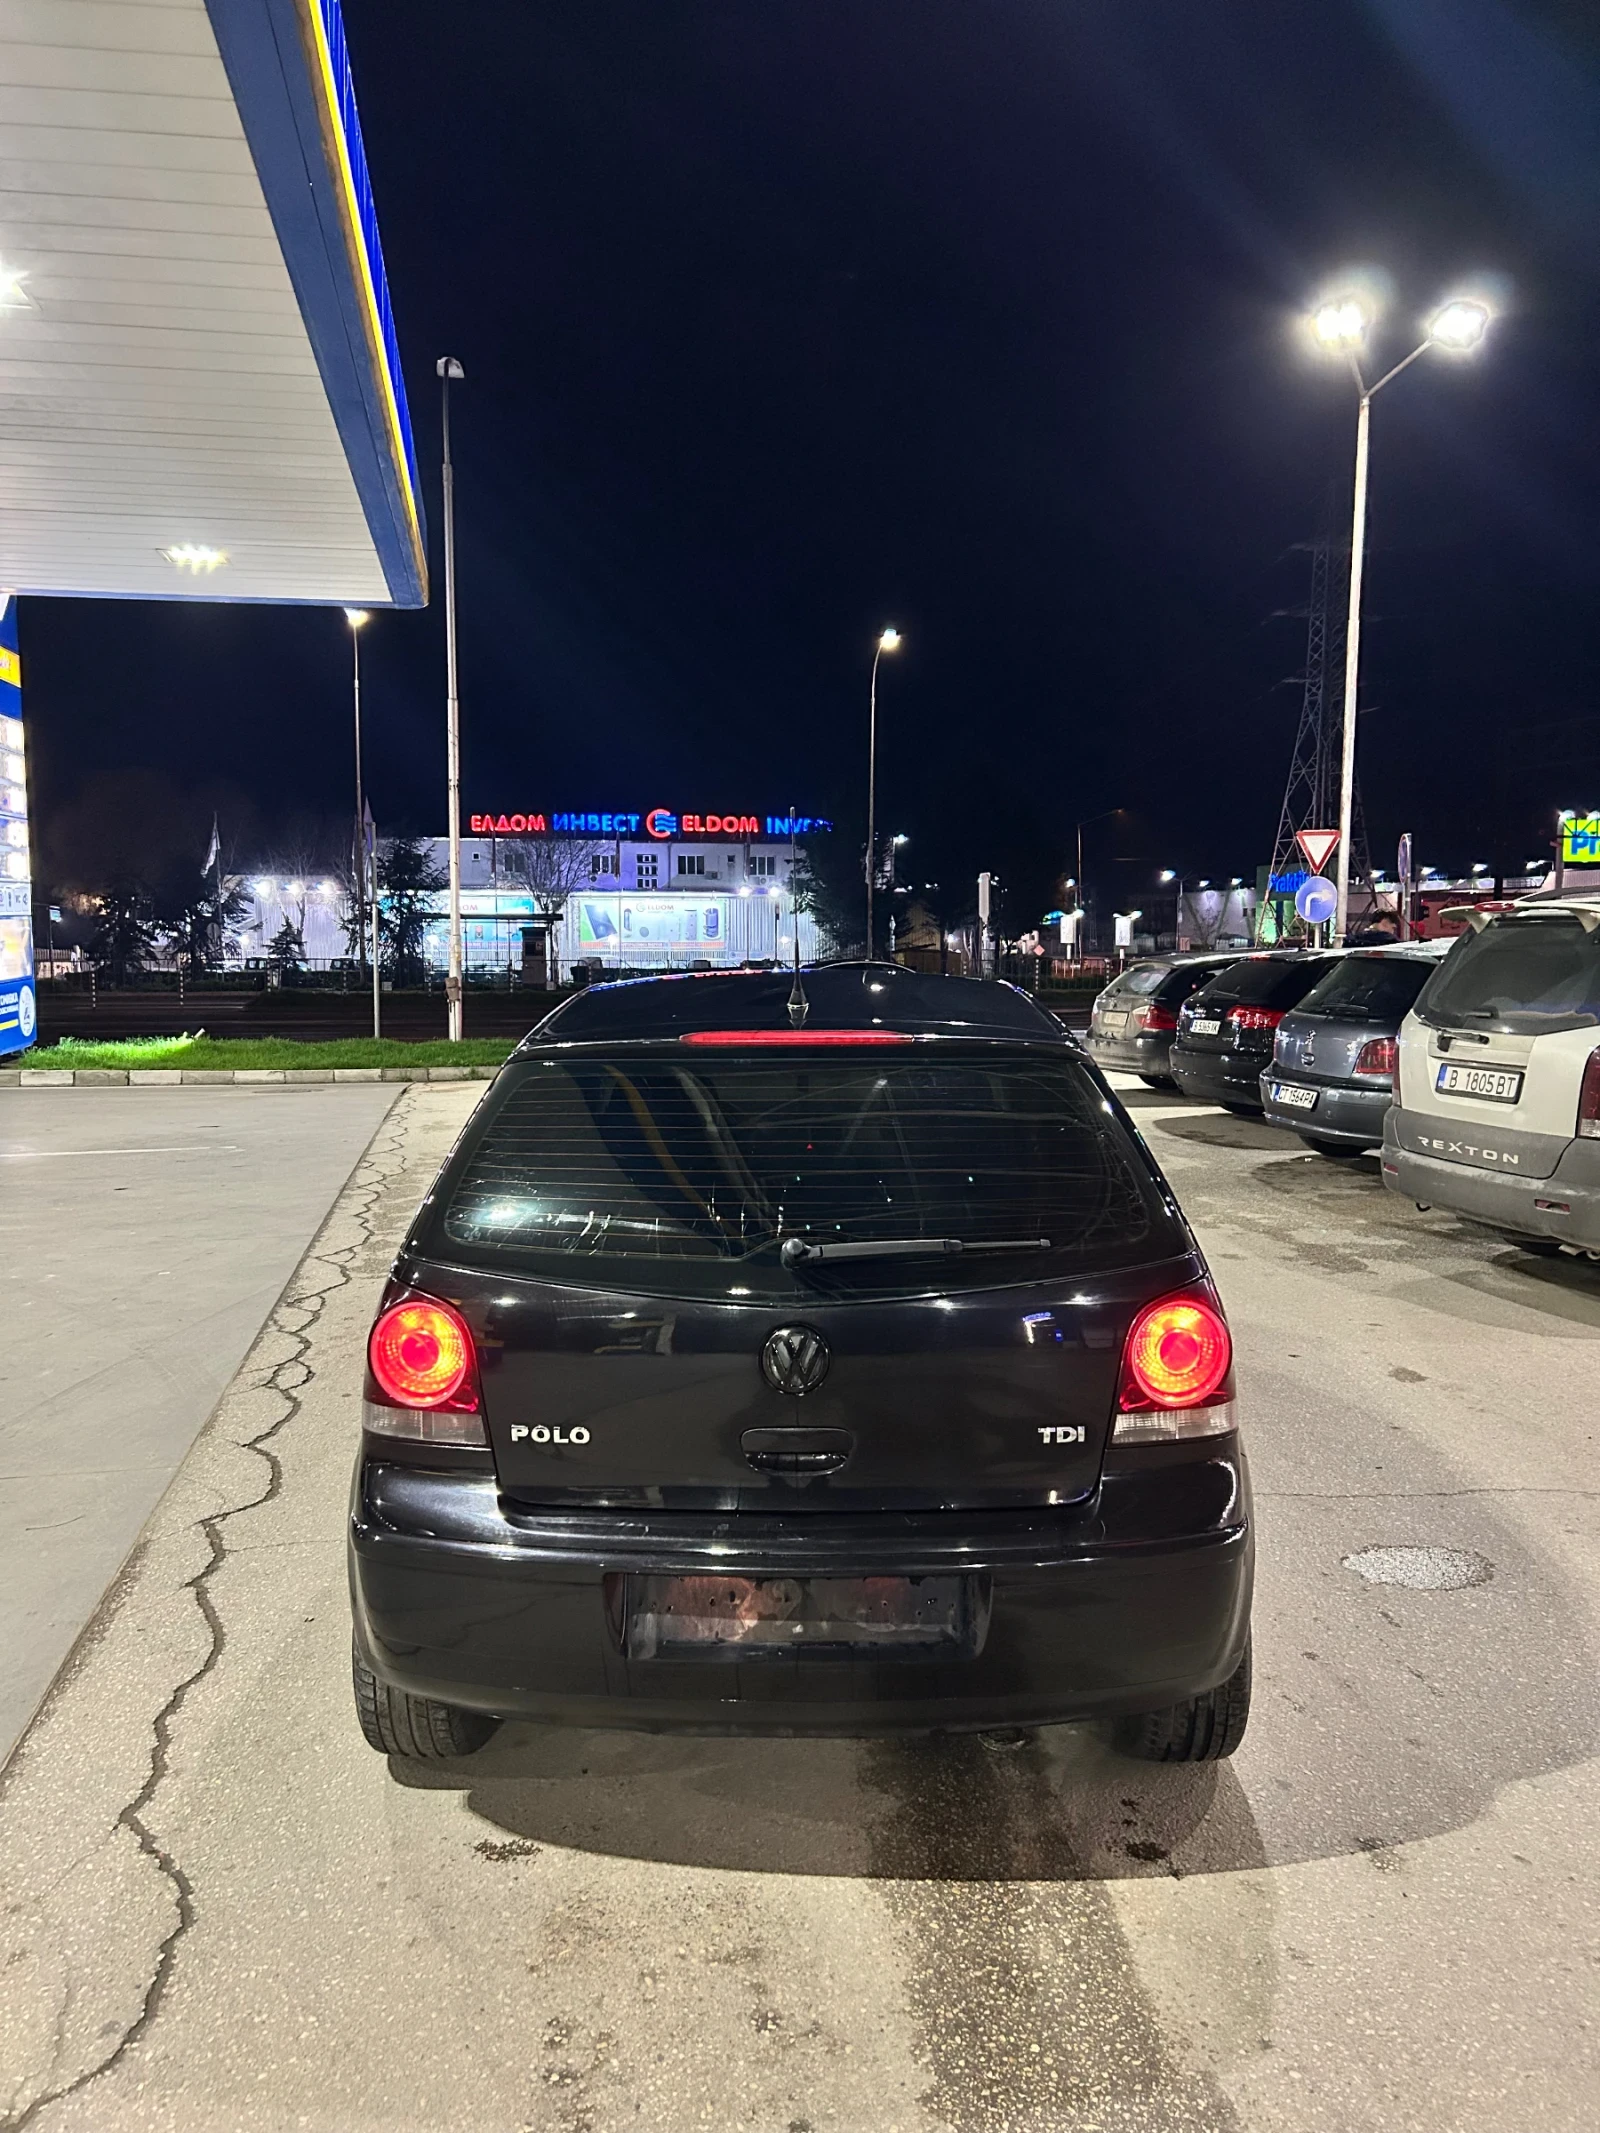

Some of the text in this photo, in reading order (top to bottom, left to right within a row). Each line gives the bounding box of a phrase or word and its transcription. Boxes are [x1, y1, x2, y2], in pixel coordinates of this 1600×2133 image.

[470, 813, 640, 832] ЕЛДОМ ИНВЕСТ
[682, 815, 759, 833] ELDOM
[1571, 831, 1600, 855] Pr
[1448, 1069, 1459, 1089] B
[1417, 1136, 1519, 1165] REXTON
[511, 1424, 590, 1444] POLO
[1037, 1426, 1085, 1443] TDI
